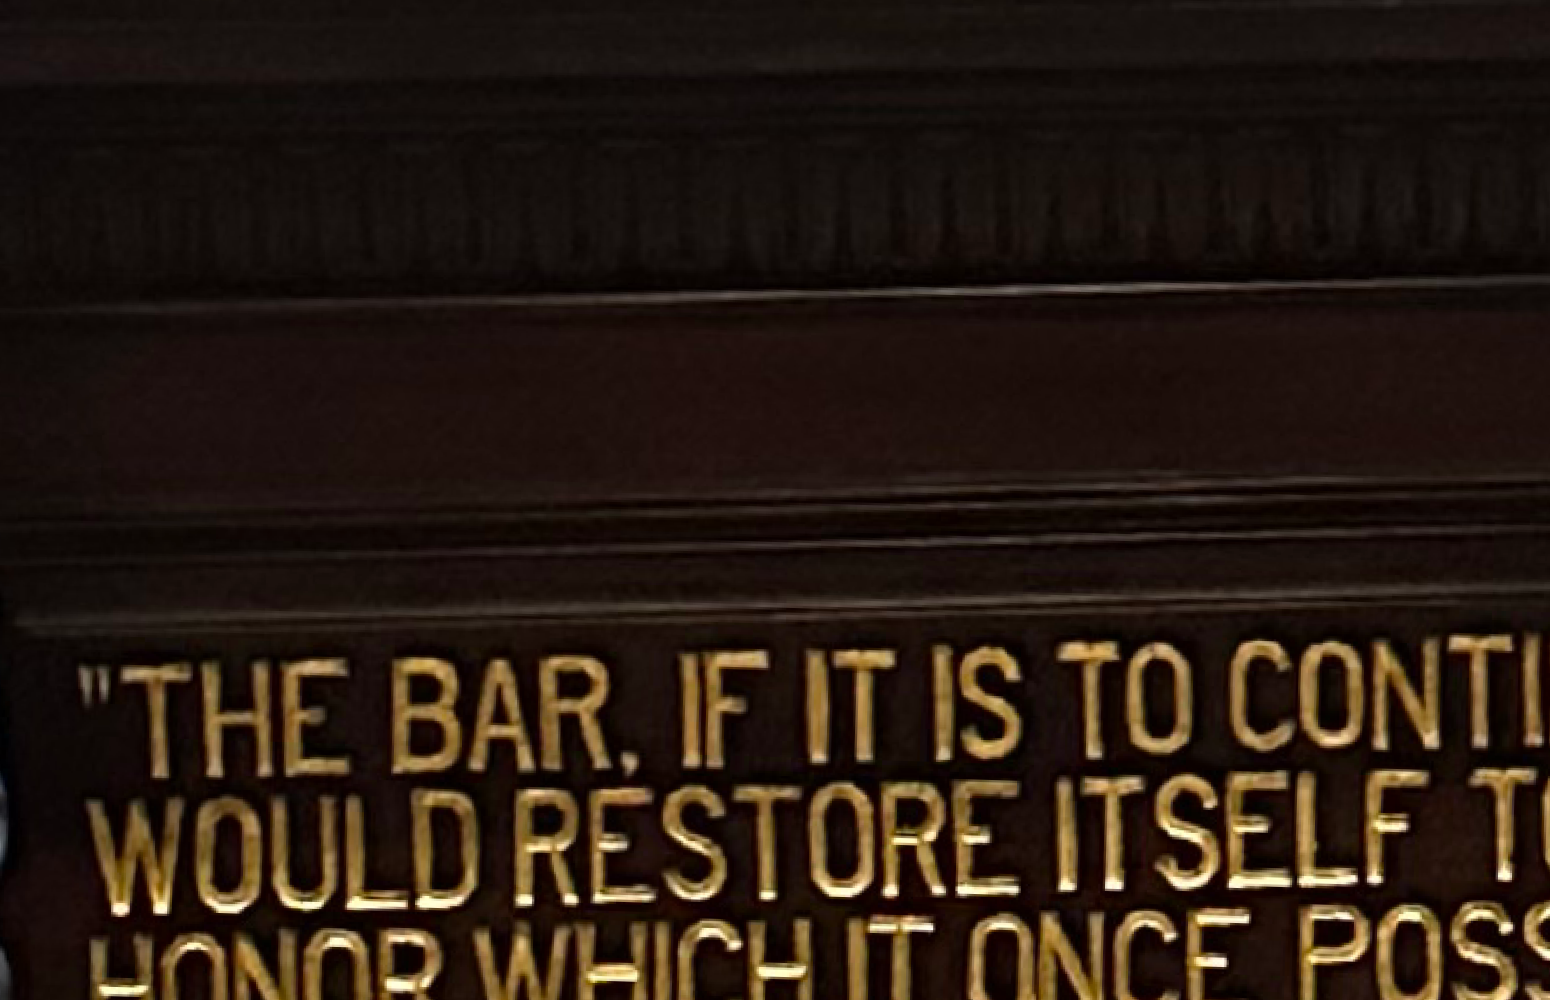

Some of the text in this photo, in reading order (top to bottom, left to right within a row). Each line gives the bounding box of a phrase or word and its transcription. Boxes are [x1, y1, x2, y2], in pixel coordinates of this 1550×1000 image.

[79, 659, 350, 779] "THE
[391, 655, 640, 776] BAR,
[679, 649, 770, 769] IF
[806, 649, 896, 764] IT
[932, 645, 1022, 762] IS
[1057, 640, 1193, 760] TO
[87, 789, 479, 915] WOULD
[514, 780, 1022, 906] RESTORE
[1056, 769, 1430, 892] ITSELF
[90, 926, 443, 1000] HONOR
[472, 918, 813, 1000] WHICH
[847, 914, 935, 1000] IT
